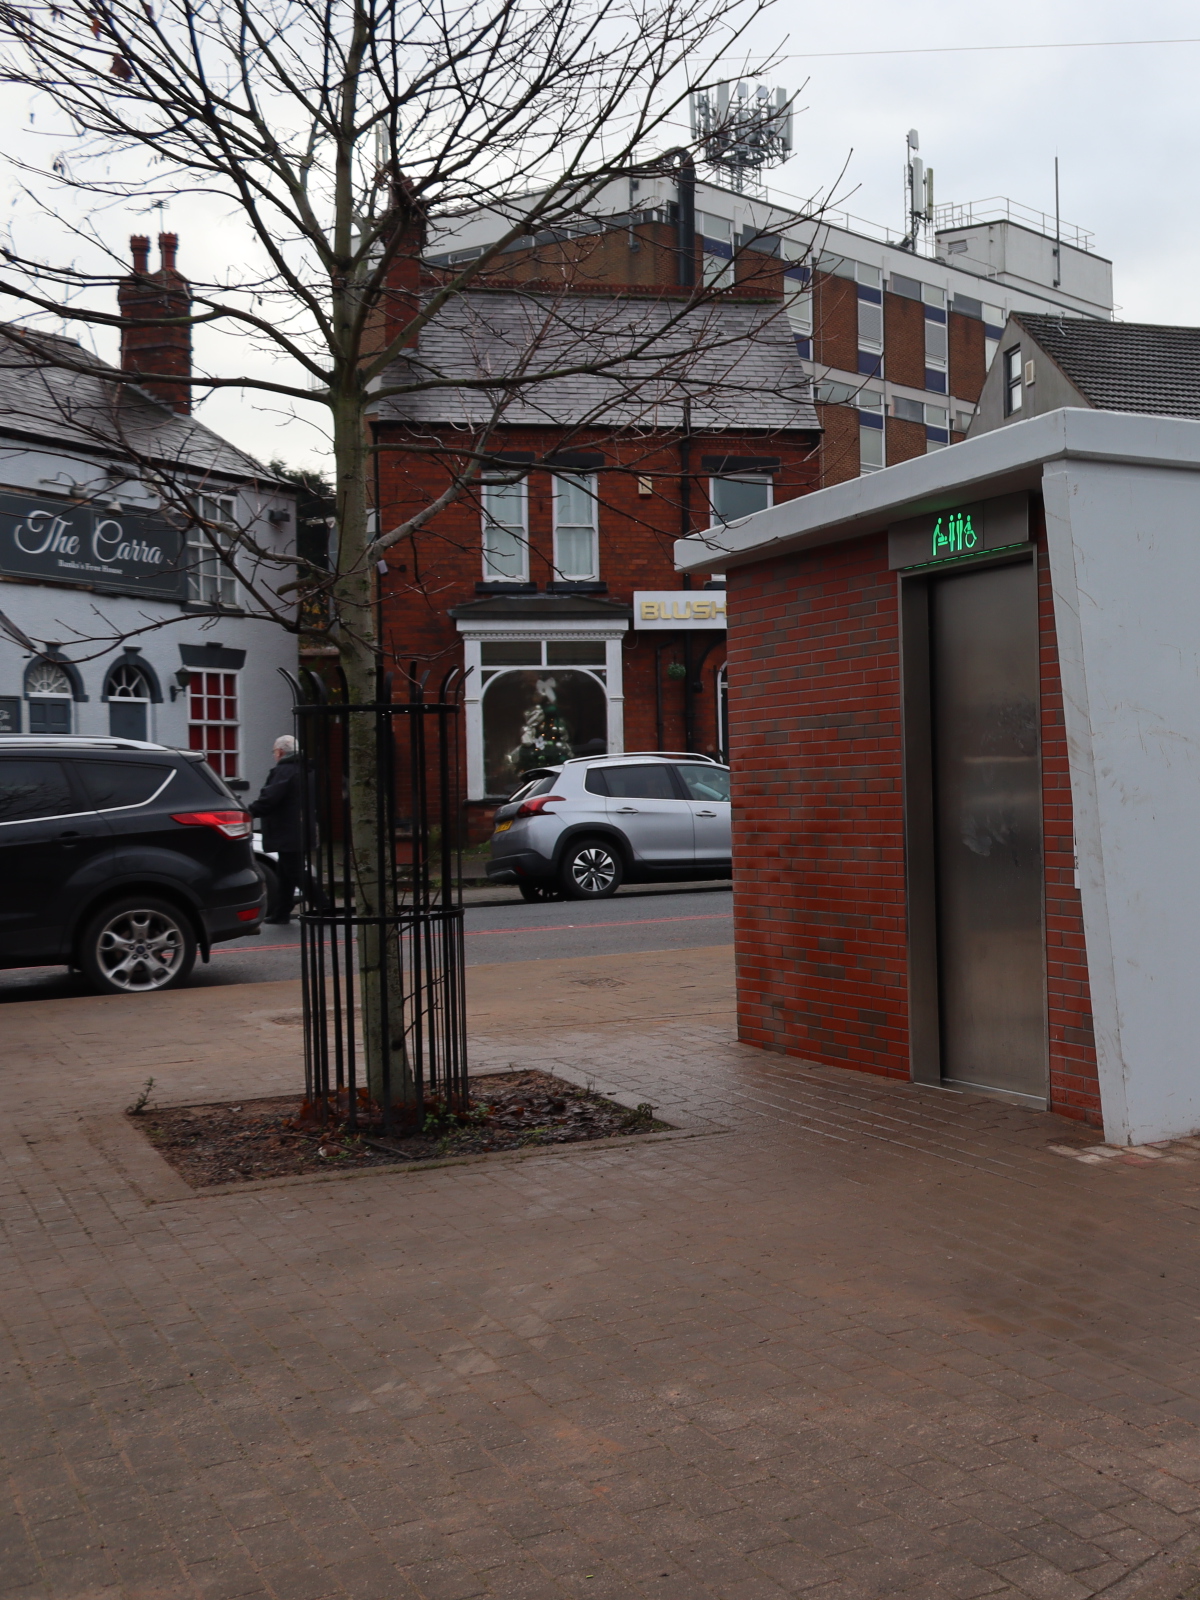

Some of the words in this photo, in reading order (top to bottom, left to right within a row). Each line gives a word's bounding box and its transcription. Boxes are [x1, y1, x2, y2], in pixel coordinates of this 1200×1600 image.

[14, 510, 80, 555] The
[92, 517, 164, 565] Carra
[641, 601, 727, 620] BLUSH
